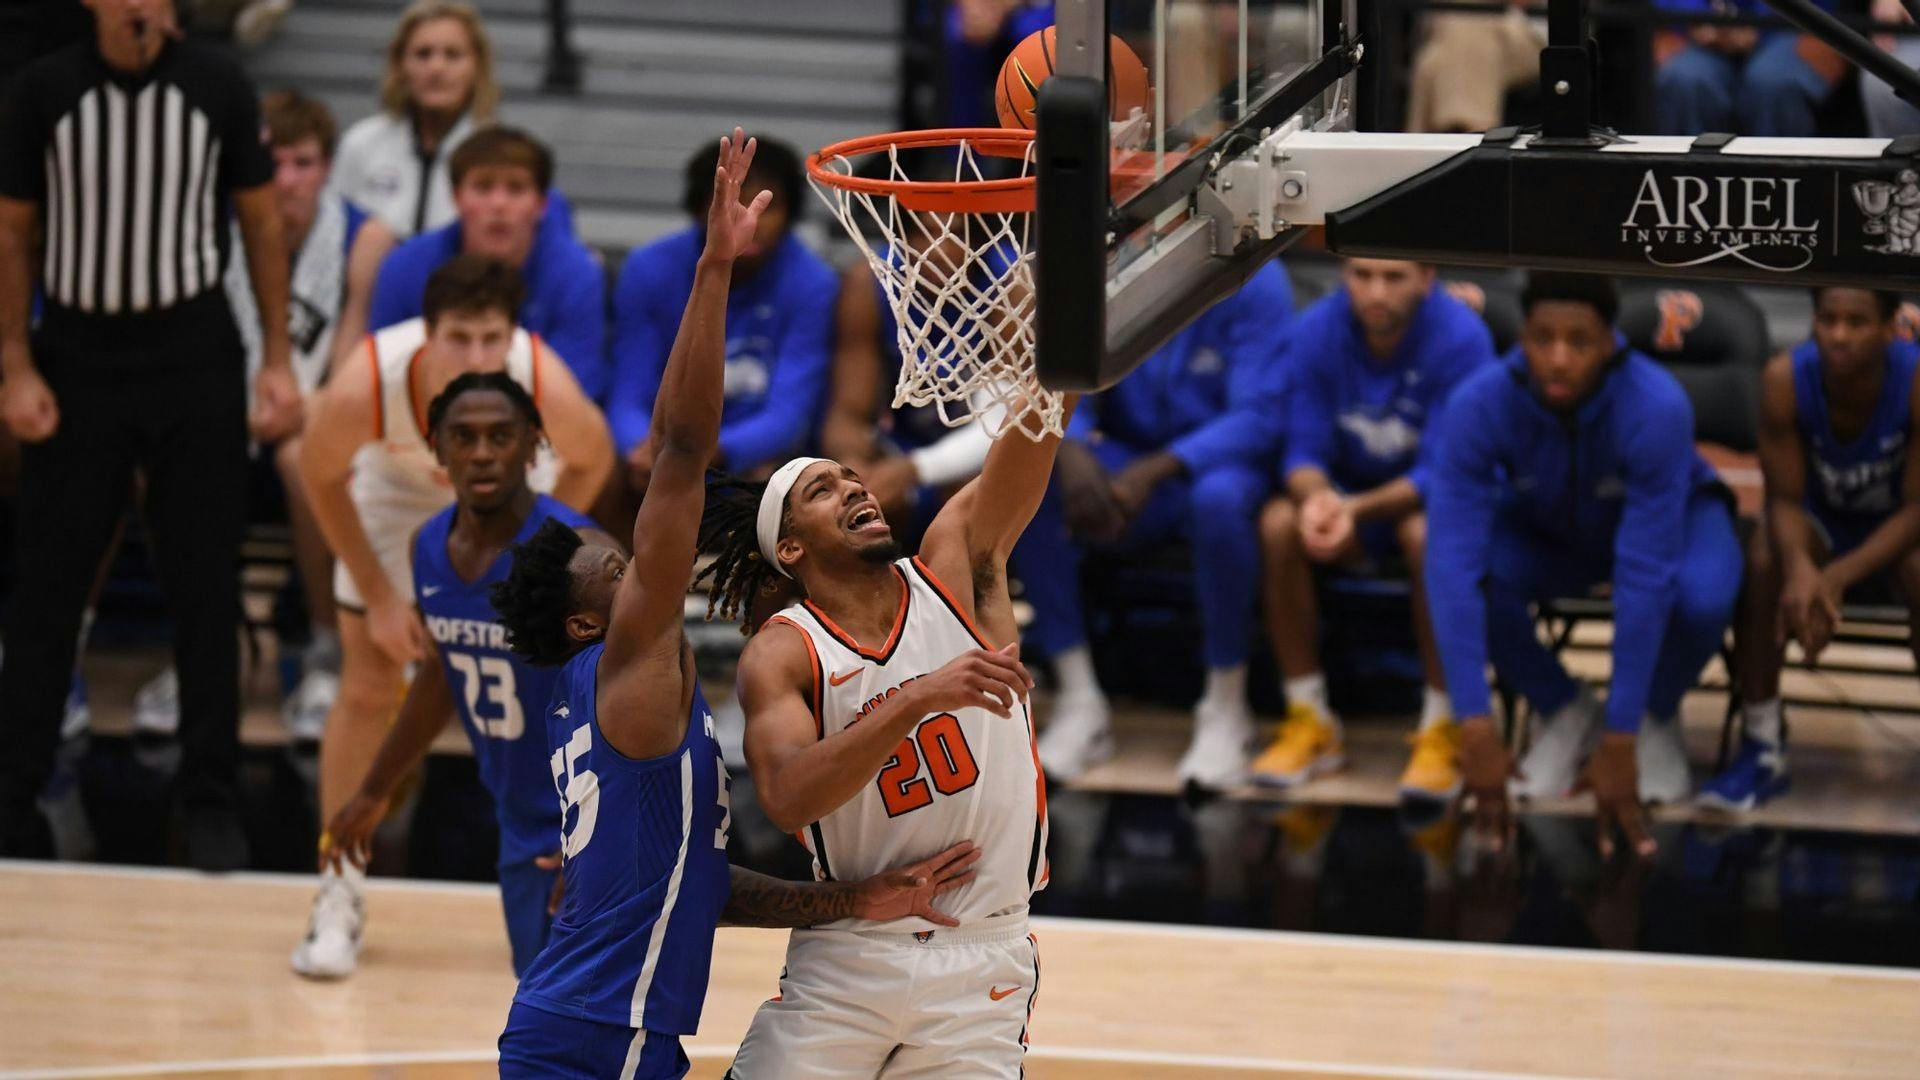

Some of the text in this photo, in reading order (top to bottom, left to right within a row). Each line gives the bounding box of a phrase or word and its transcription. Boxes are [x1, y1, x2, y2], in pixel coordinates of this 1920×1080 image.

[1621, 168, 1820, 232] ARIEL
[1621, 228, 1818, 247] INVESTMENTS
[1655, 289, 1703, 349] P
[447, 651, 525, 741] 23
[876, 712, 980, 819] 20
